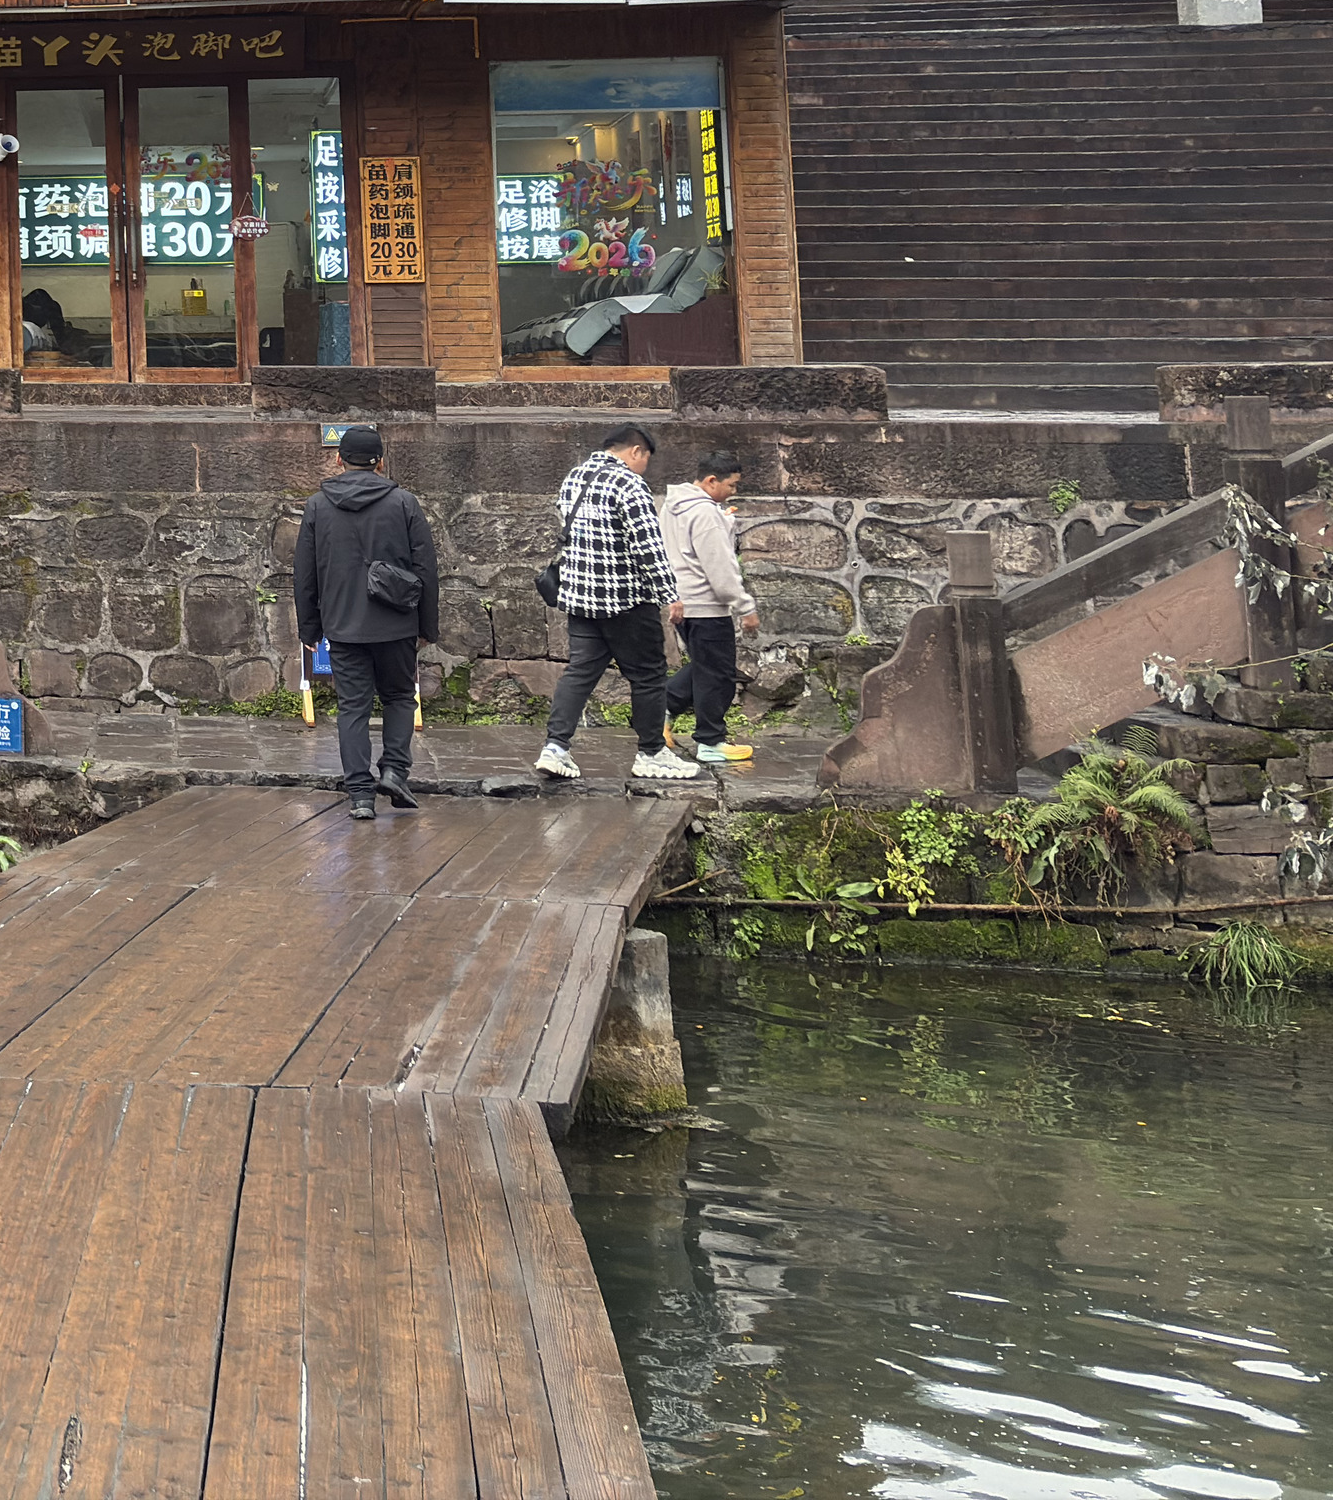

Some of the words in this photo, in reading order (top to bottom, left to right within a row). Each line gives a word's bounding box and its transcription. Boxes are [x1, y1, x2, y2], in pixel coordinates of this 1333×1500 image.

[315, 136, 343, 167] 足
[316, 172, 345, 203] 按
[498, 180, 561, 205] 足浴
[317, 210, 347, 242] 采
[368, 164, 392, 277] 苗药泡脚20元
[393, 164, 418, 276] 肩颈疏通30元
[499, 208, 561, 233] 修脚
[319, 246, 348, 278] 修
[499, 236, 563, 260] 按摩
[558, 227, 656, 272] 2026
